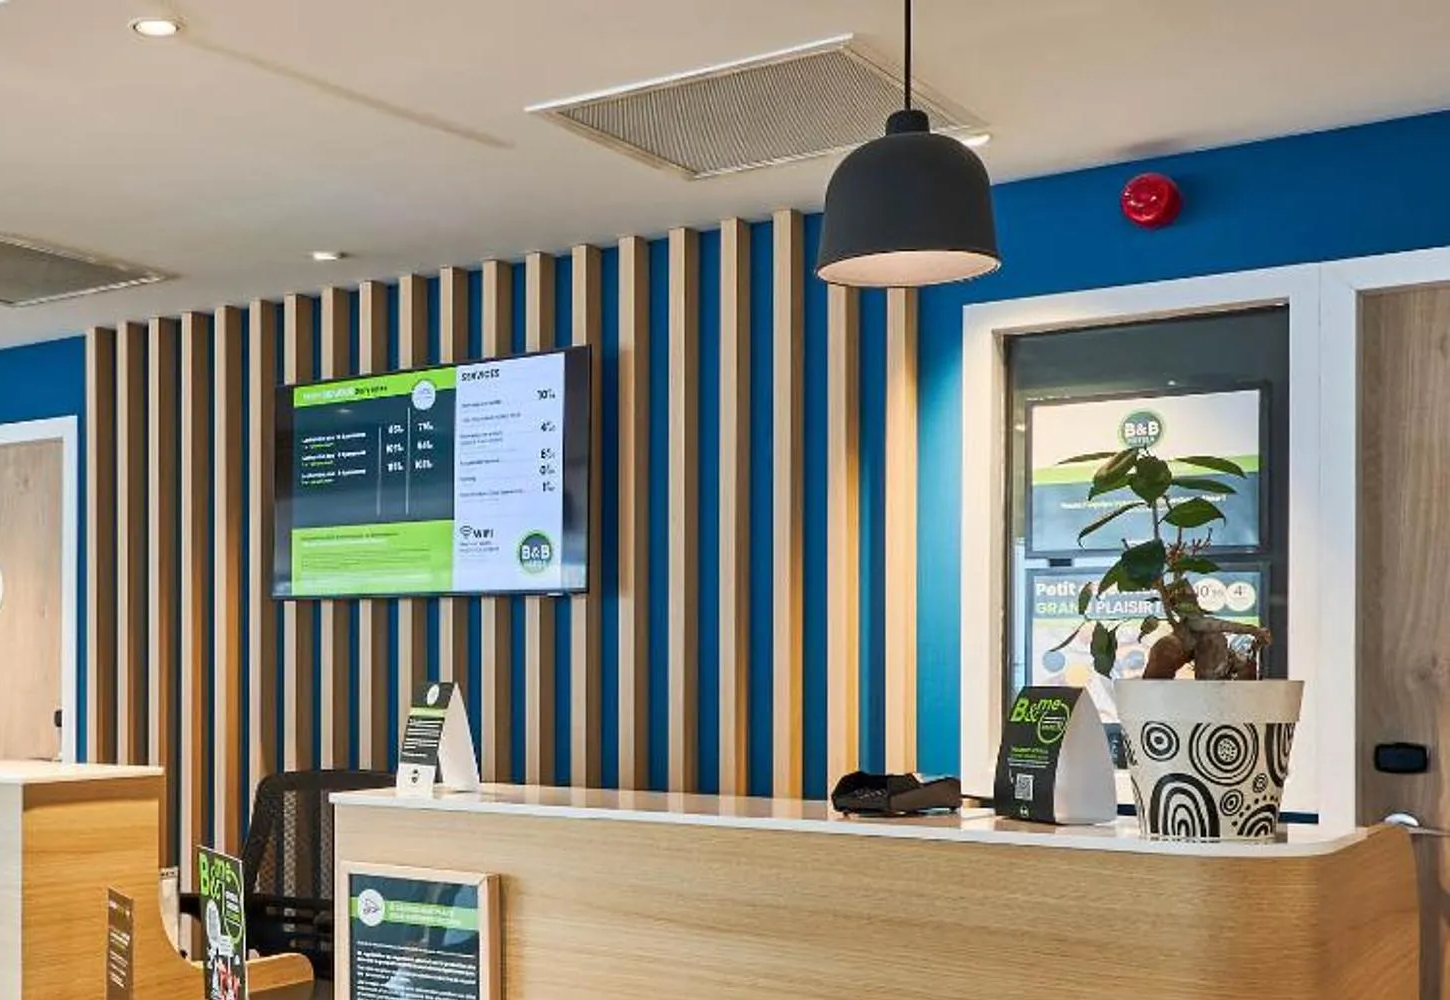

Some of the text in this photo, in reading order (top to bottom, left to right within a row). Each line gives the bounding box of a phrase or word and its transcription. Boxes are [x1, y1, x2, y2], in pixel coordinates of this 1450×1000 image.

[1124, 420, 1159, 438] B&B
[521, 544, 550, 560] B&B
[1036, 601, 1090, 615] GRAN
[1095, 600, 1152, 614] PLAISIR
